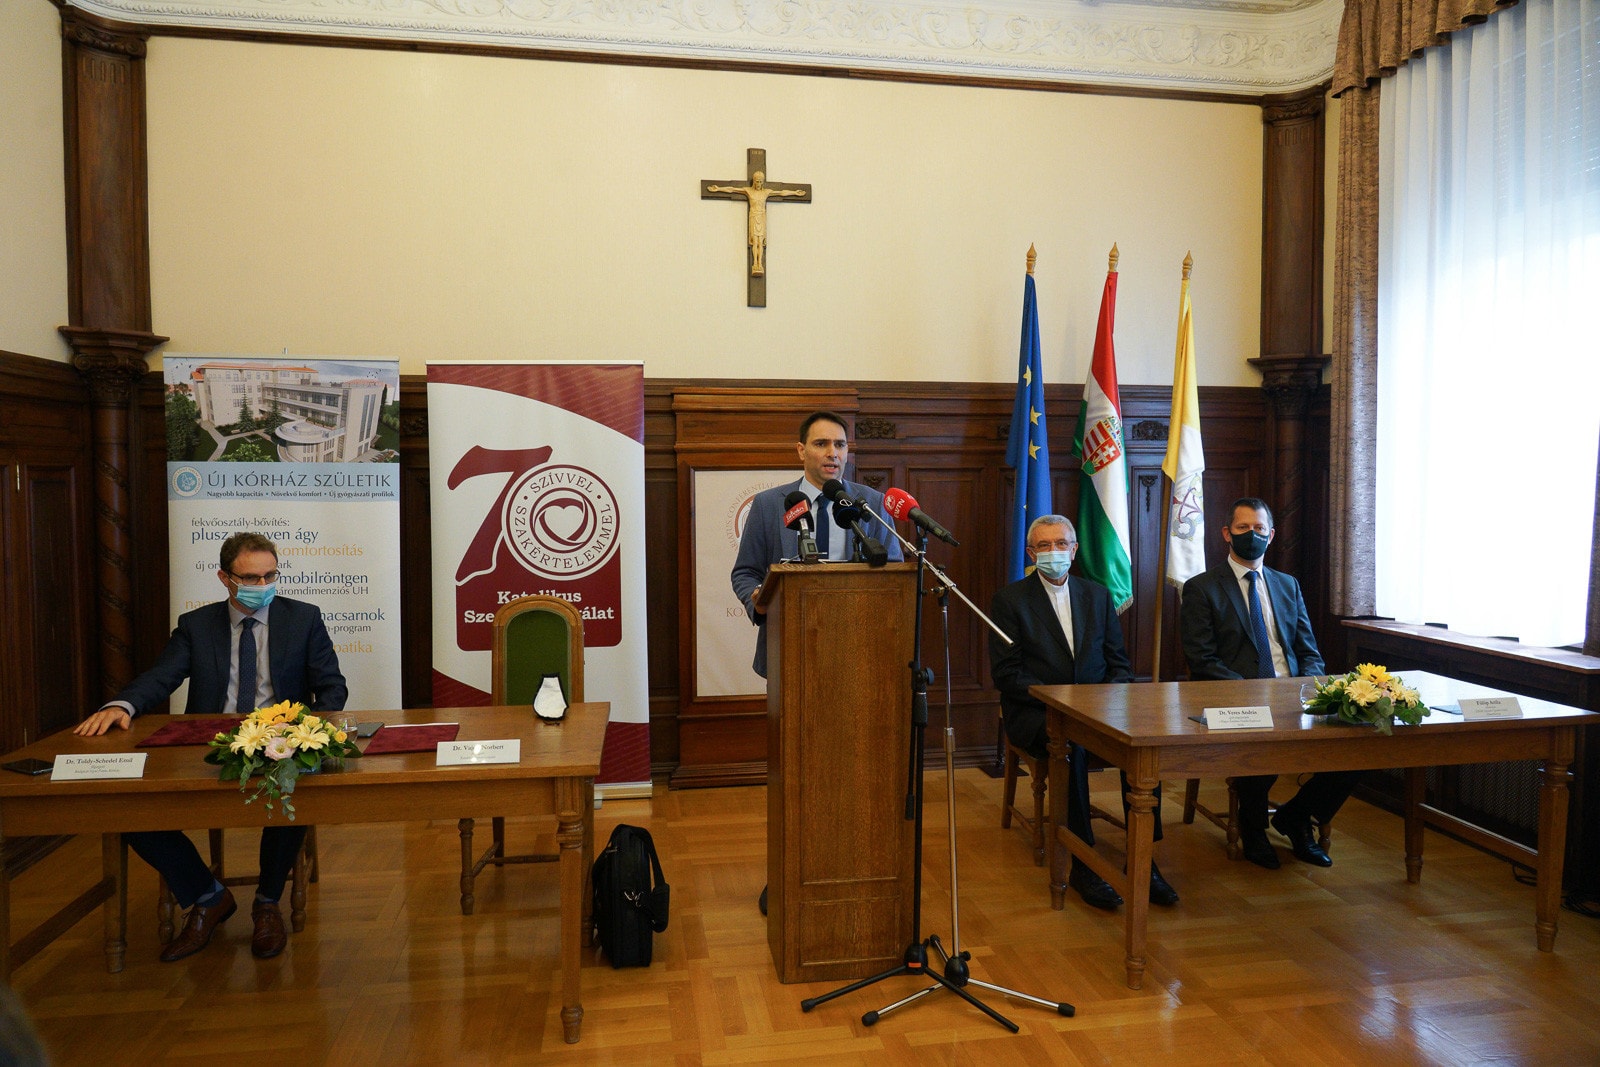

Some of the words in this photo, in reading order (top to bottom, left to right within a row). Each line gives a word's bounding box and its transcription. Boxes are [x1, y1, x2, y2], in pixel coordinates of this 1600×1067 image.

[207, 470, 226, 488] ÚJ
[234, 470, 308, 487] KÓRHÁZ
[314, 471, 391, 487] SZÜLETIK
[529, 472, 593, 494] SZÍVVEL
[206, 490, 235, 498] Nagyobb
[235, 490, 264, 498] kapacitás
[371, 490, 395, 498] profilok
[191, 528, 228, 544] plusz
[295, 527, 319, 544] ágy
[514, 503, 613, 569] SZAKÉRTELEMMEL
[274, 543, 364, 557] komfortosítás
[195, 559, 205, 570] új
[279, 570, 368, 587] mobilröntgen
[352, 586, 369, 595] UH
[497, 589, 582, 605] Kakus
[320, 607, 385, 622] nacsarnok
